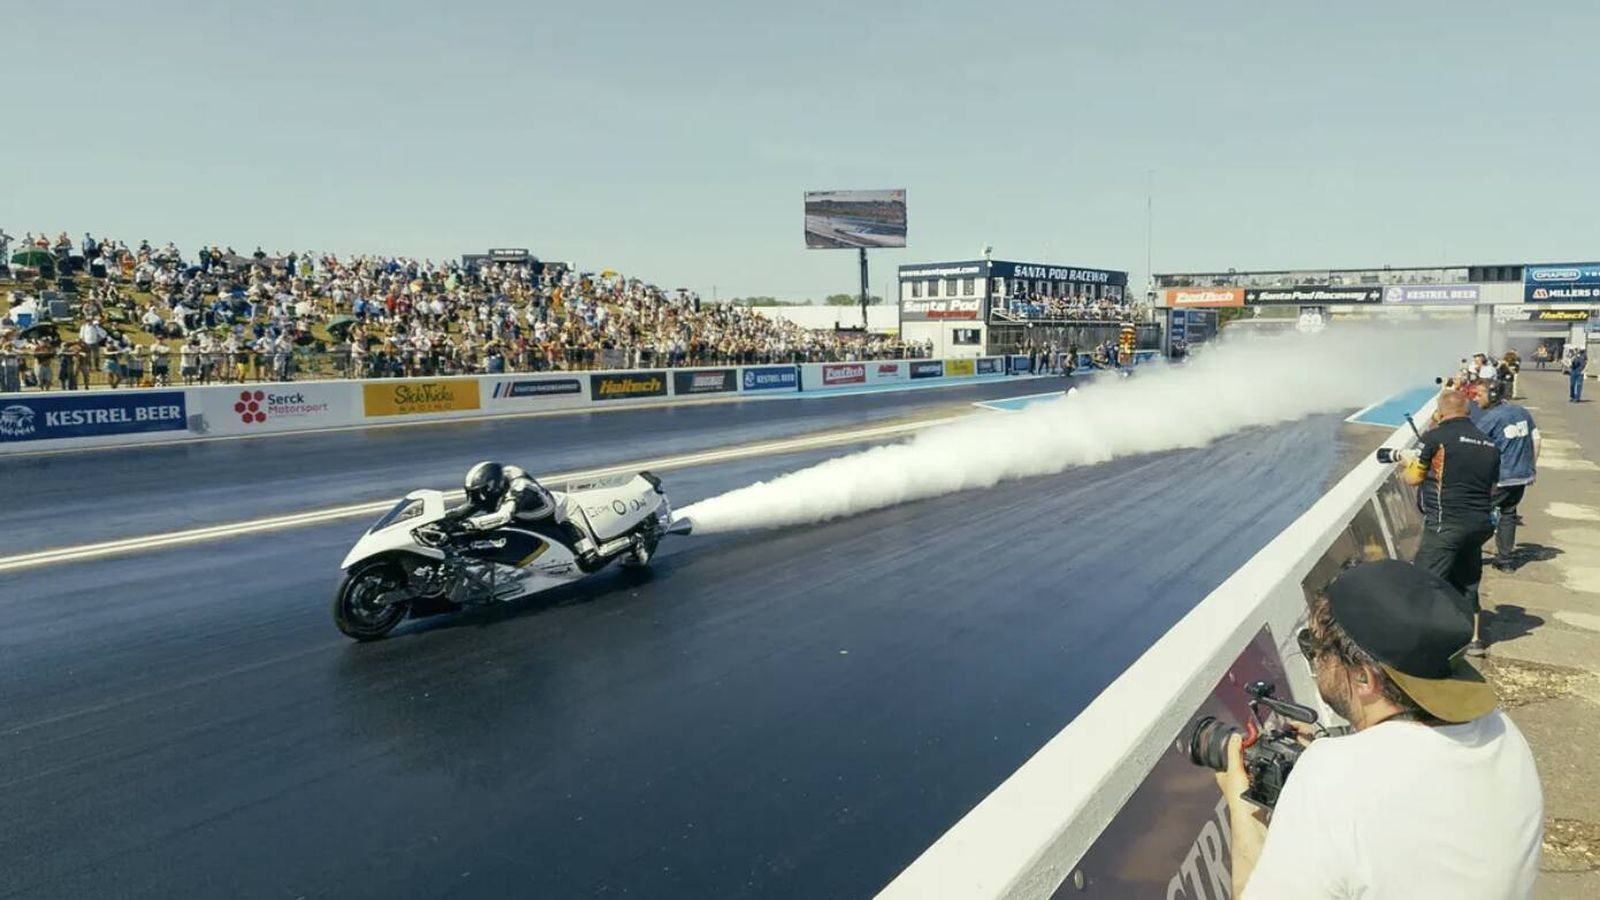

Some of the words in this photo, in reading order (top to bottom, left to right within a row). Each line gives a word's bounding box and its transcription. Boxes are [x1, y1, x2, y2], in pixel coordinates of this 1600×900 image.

[1014, 265, 1046, 278] SANTA
[1048, 268, 1068, 280] POD
[1069, 270, 1109, 283] RACEWAY
[1259, 291, 1291, 300] Santa
[1292, 291, 1314, 300] Pod
[1315, 291, 1367, 301] Raceway
[1407, 290, 1447, 299] KESTREL
[1450, 290, 1476, 299] BEER
[1549, 288, 1591, 297] MILLERS
[903, 301, 947, 313] Santa
[951, 299, 980, 312] Pod
[1539, 311, 1588, 319] Haltech
[600, 377, 661, 394] Haltech
[268, 393, 304, 405] Serck
[268, 403, 328, 414] Motorsport
[46, 408, 131, 427] KESTREL
[135, 405, 181, 421] BEER
